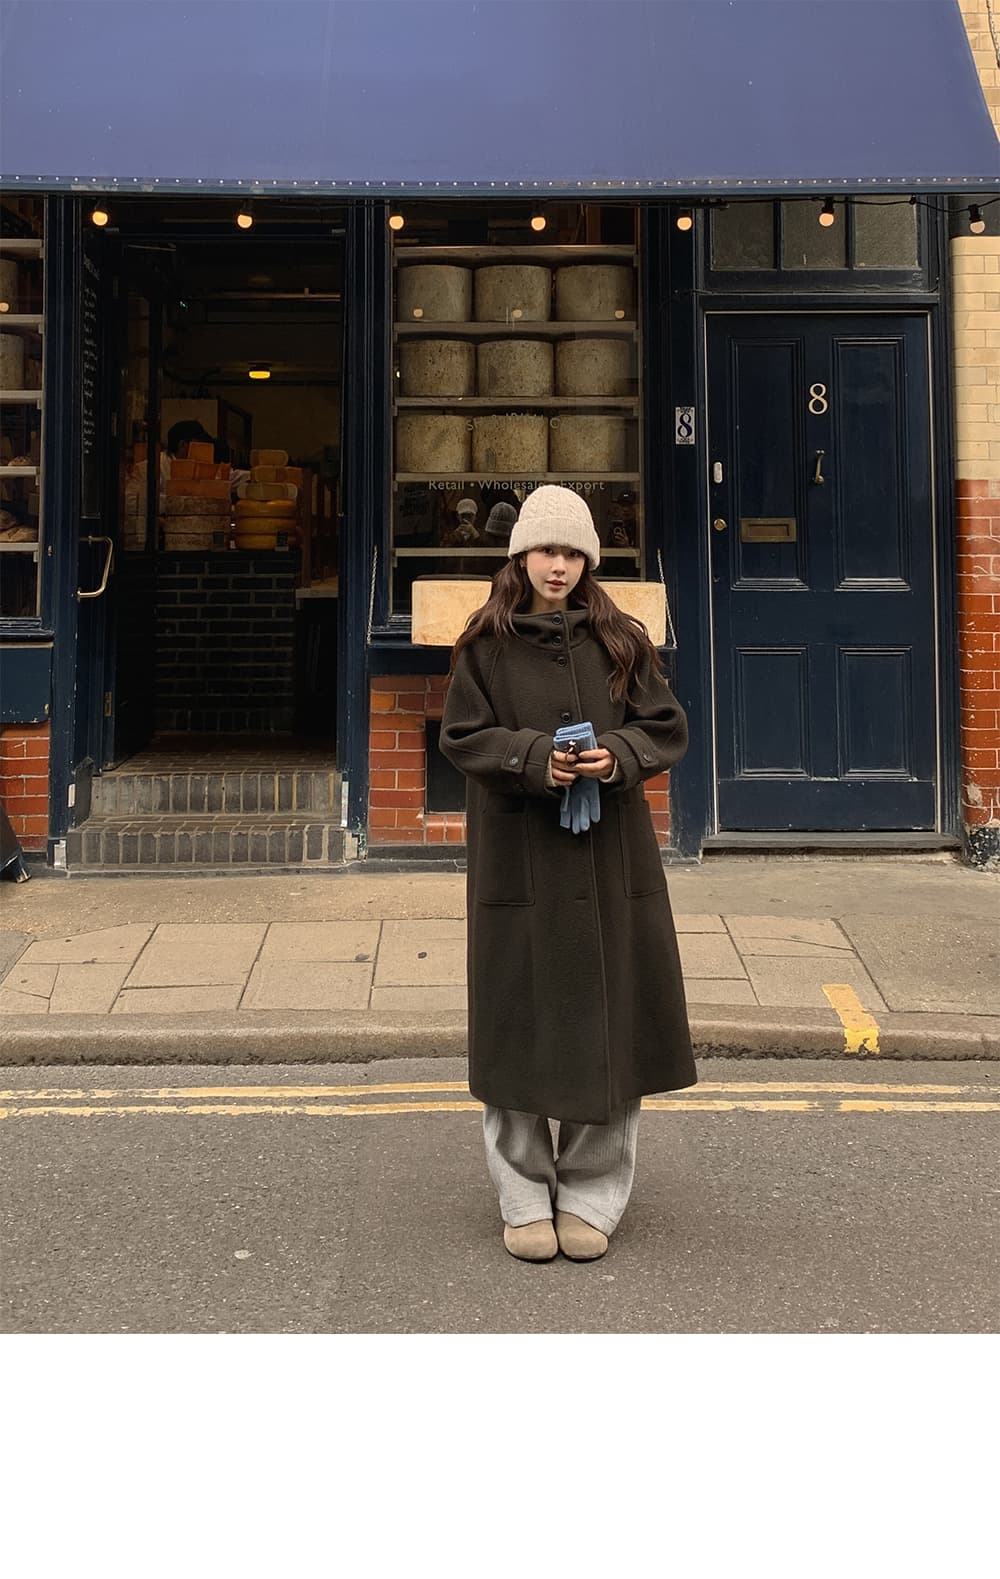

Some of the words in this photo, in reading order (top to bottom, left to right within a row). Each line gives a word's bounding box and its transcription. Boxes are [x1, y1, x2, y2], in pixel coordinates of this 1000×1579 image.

[808, 383, 828, 415] 8
[677, 413, 693, 438] 8
[428, 480, 465, 490] Retail
